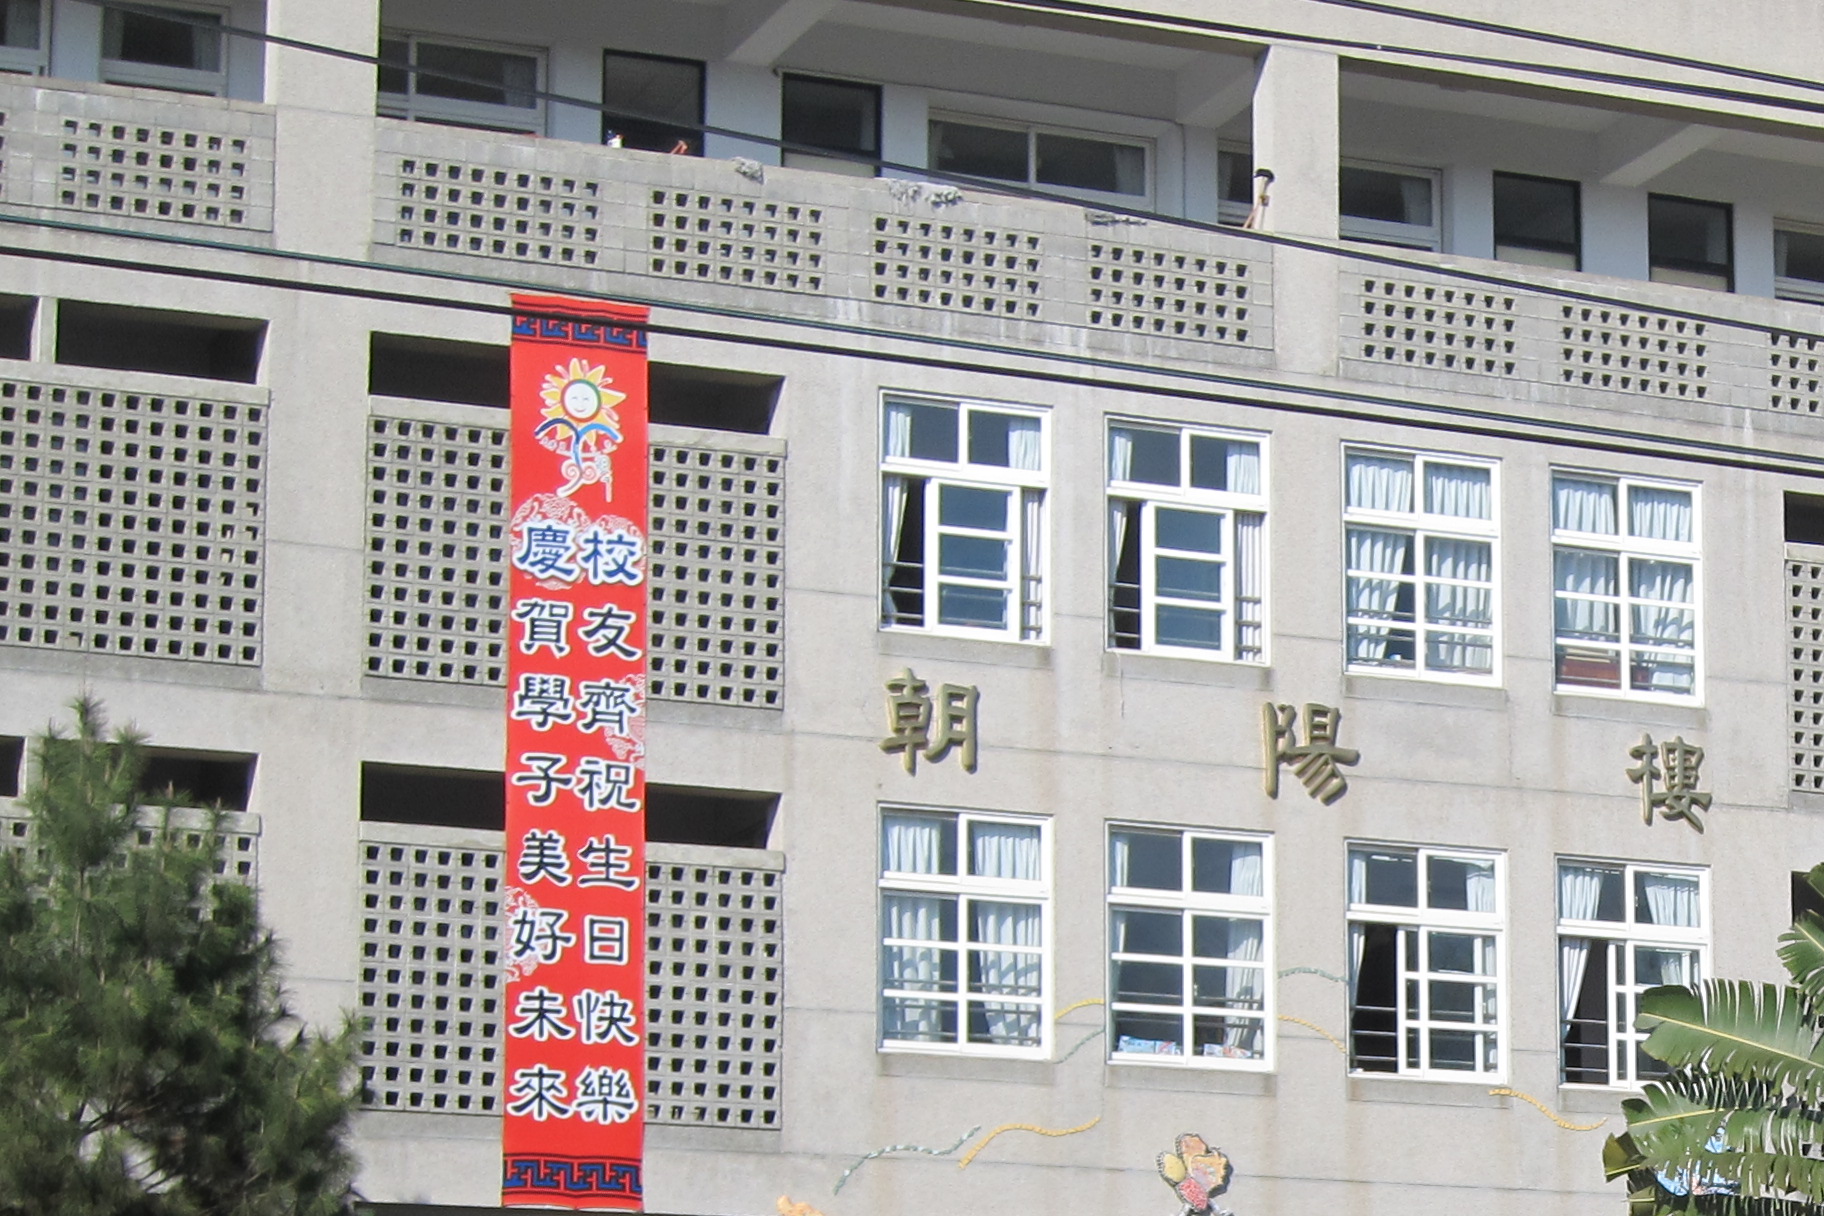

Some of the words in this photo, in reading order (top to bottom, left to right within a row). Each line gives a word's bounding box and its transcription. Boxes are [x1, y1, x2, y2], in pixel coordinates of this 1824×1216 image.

[511, 519, 576, 1122] 慶賀學子美好未來
[575, 522, 642, 1124] 校友齊祝生日快樂
